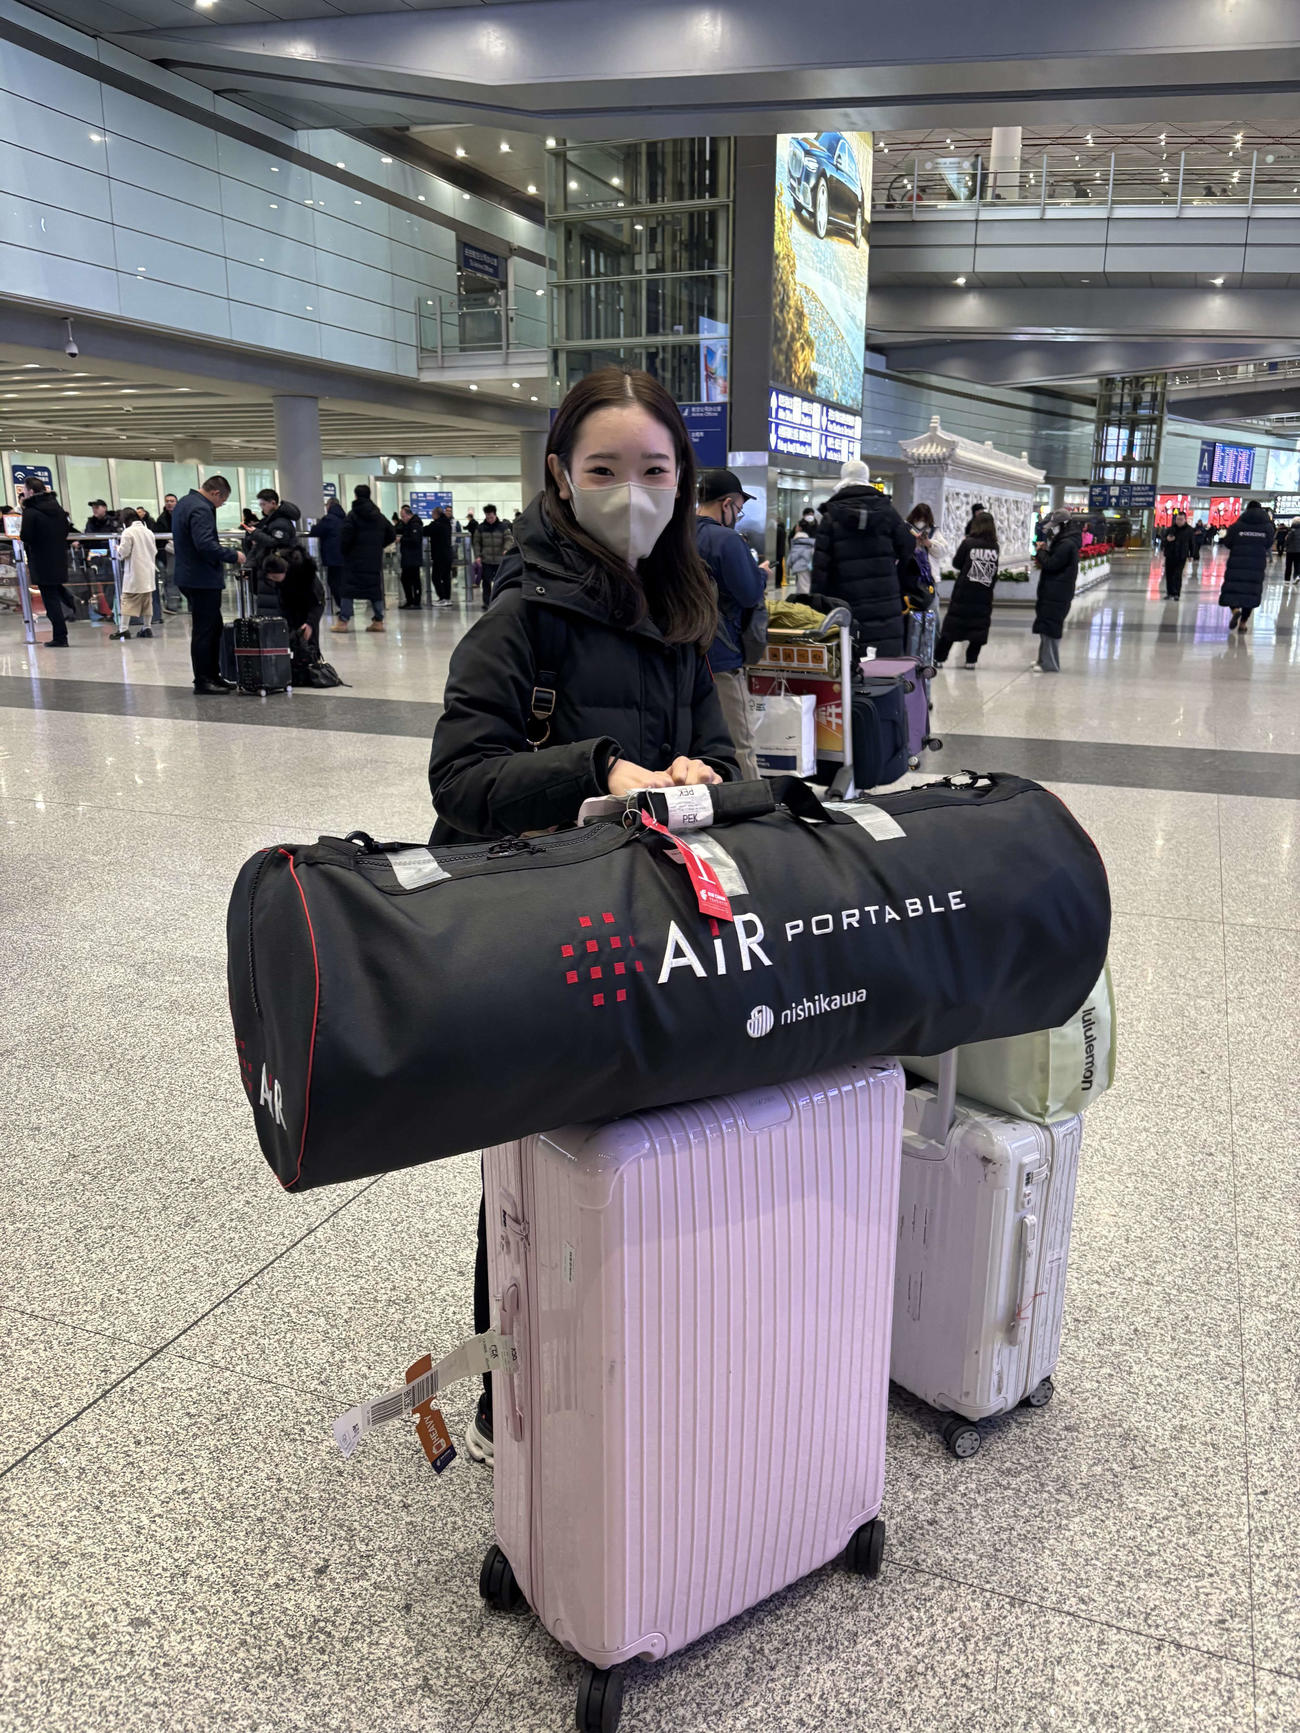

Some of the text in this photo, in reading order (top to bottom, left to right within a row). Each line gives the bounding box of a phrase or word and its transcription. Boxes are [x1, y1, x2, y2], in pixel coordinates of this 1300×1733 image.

[682, 813, 698, 824] PEK
[785, 889, 968, 942] PORTABLE
[780, 987, 868, 1026] nishikawa
[1081, 1006, 1097, 1092] lululemon
[423, 1414, 440, 1446] HEAVY
